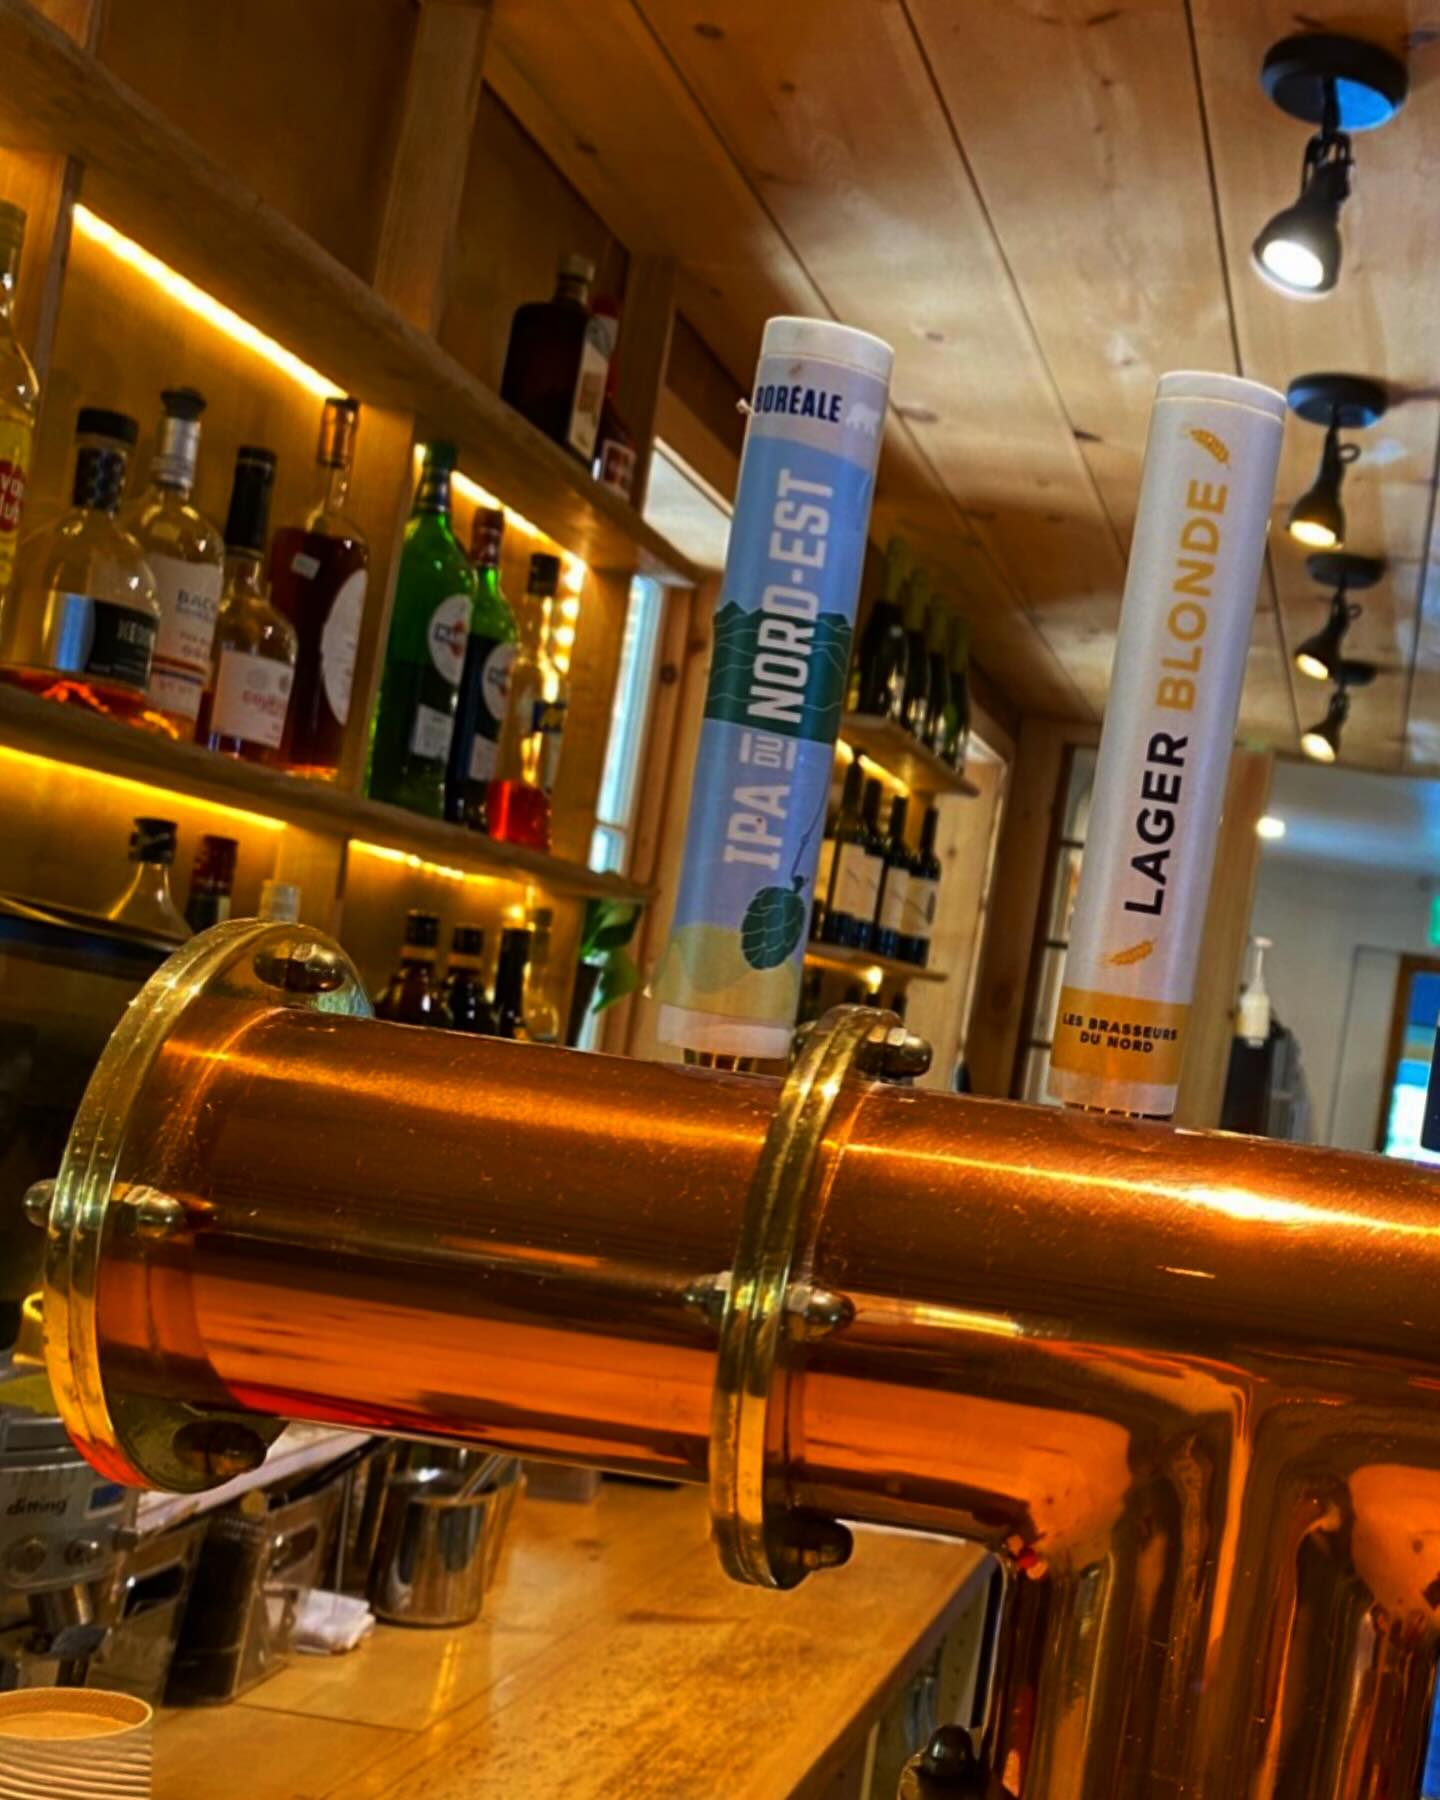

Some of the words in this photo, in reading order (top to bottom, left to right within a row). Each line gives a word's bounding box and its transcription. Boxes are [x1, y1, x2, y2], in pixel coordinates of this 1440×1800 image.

[1123, 731, 1189, 916] LAGER
[1156, 479, 1229, 713] BLONDE
[752, 734, 783, 769] DU
[723, 783, 791, 870] IPA
[1062, 1013, 1083, 1027] LES
[1088, 1017, 1178, 1041] BRASSEURS
[1080, 1031, 1101, 1045] DU
[1107, 1036, 1154, 1053] NORD
